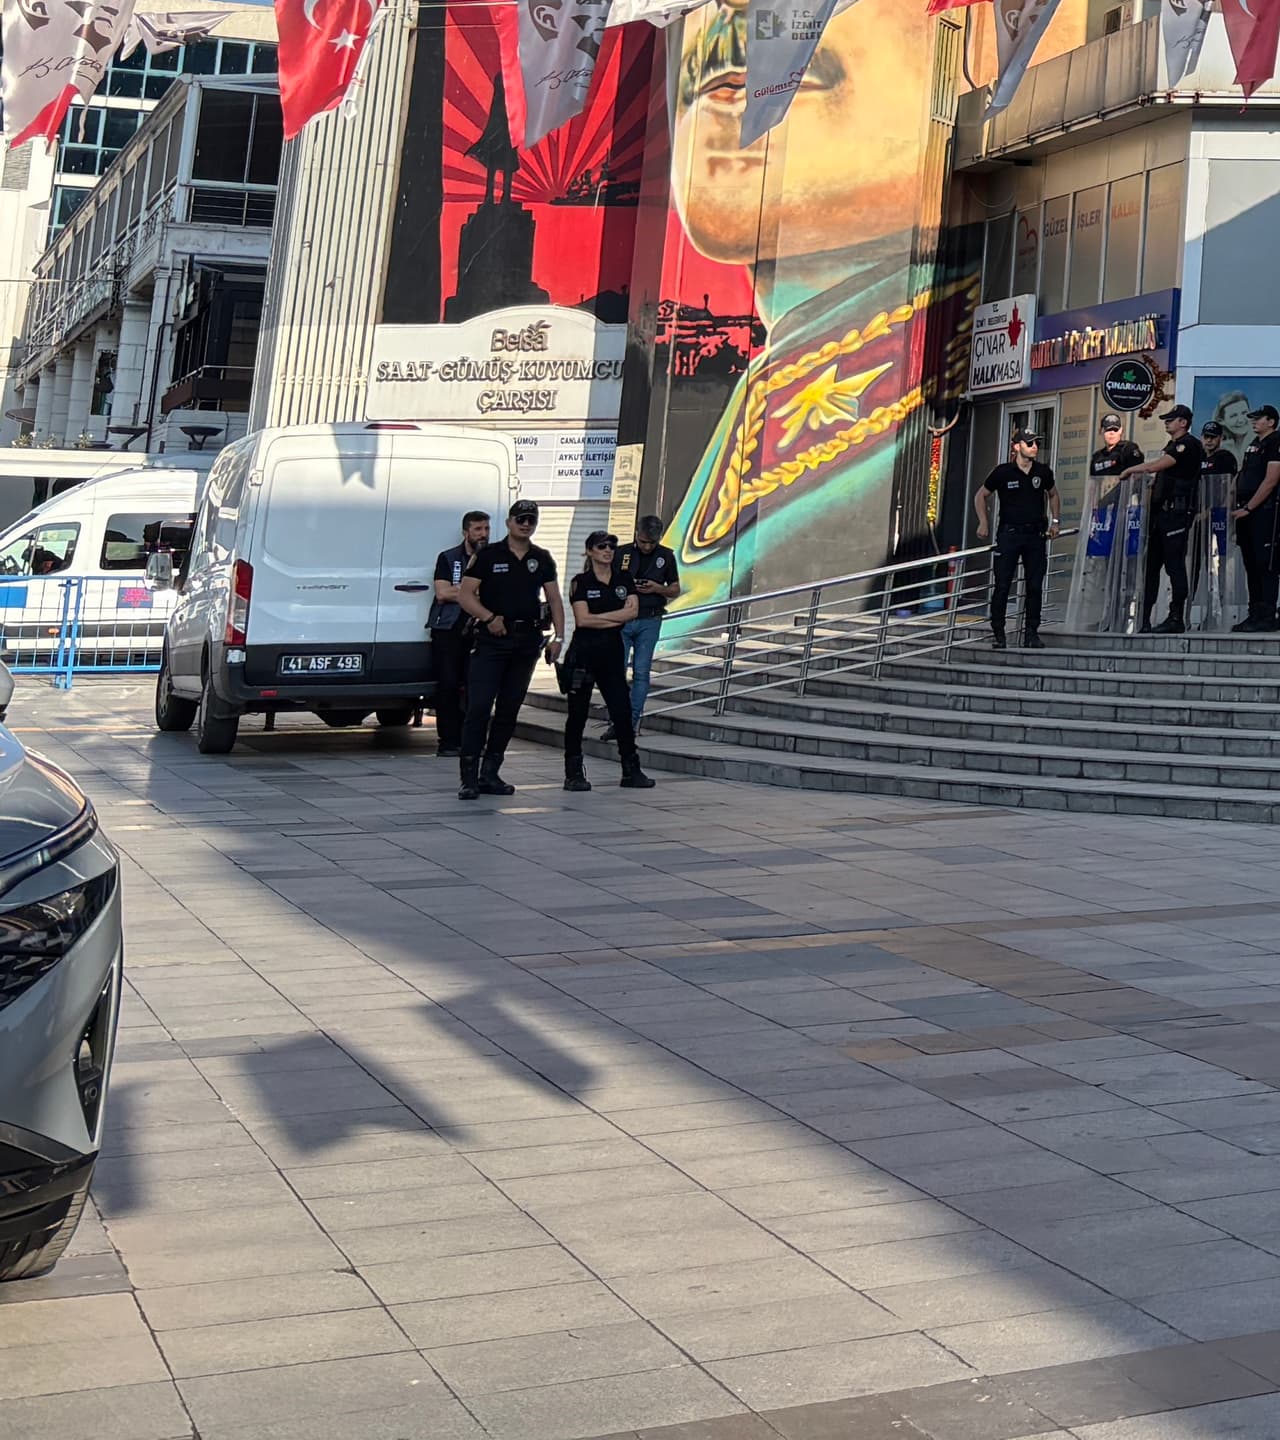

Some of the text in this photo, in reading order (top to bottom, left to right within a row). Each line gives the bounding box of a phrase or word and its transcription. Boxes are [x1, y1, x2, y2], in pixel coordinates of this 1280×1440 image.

[975, 333, 1006, 362] ÇINAR
[1105, 380, 1152, 392] ÇINARKART
[476, 388, 560, 414] ÇARŞISI
[559, 453, 584, 461] AYKUT
[558, 469, 604, 477] MURAT SAAT
[288, 657, 360, 670] 41 ASF 493
